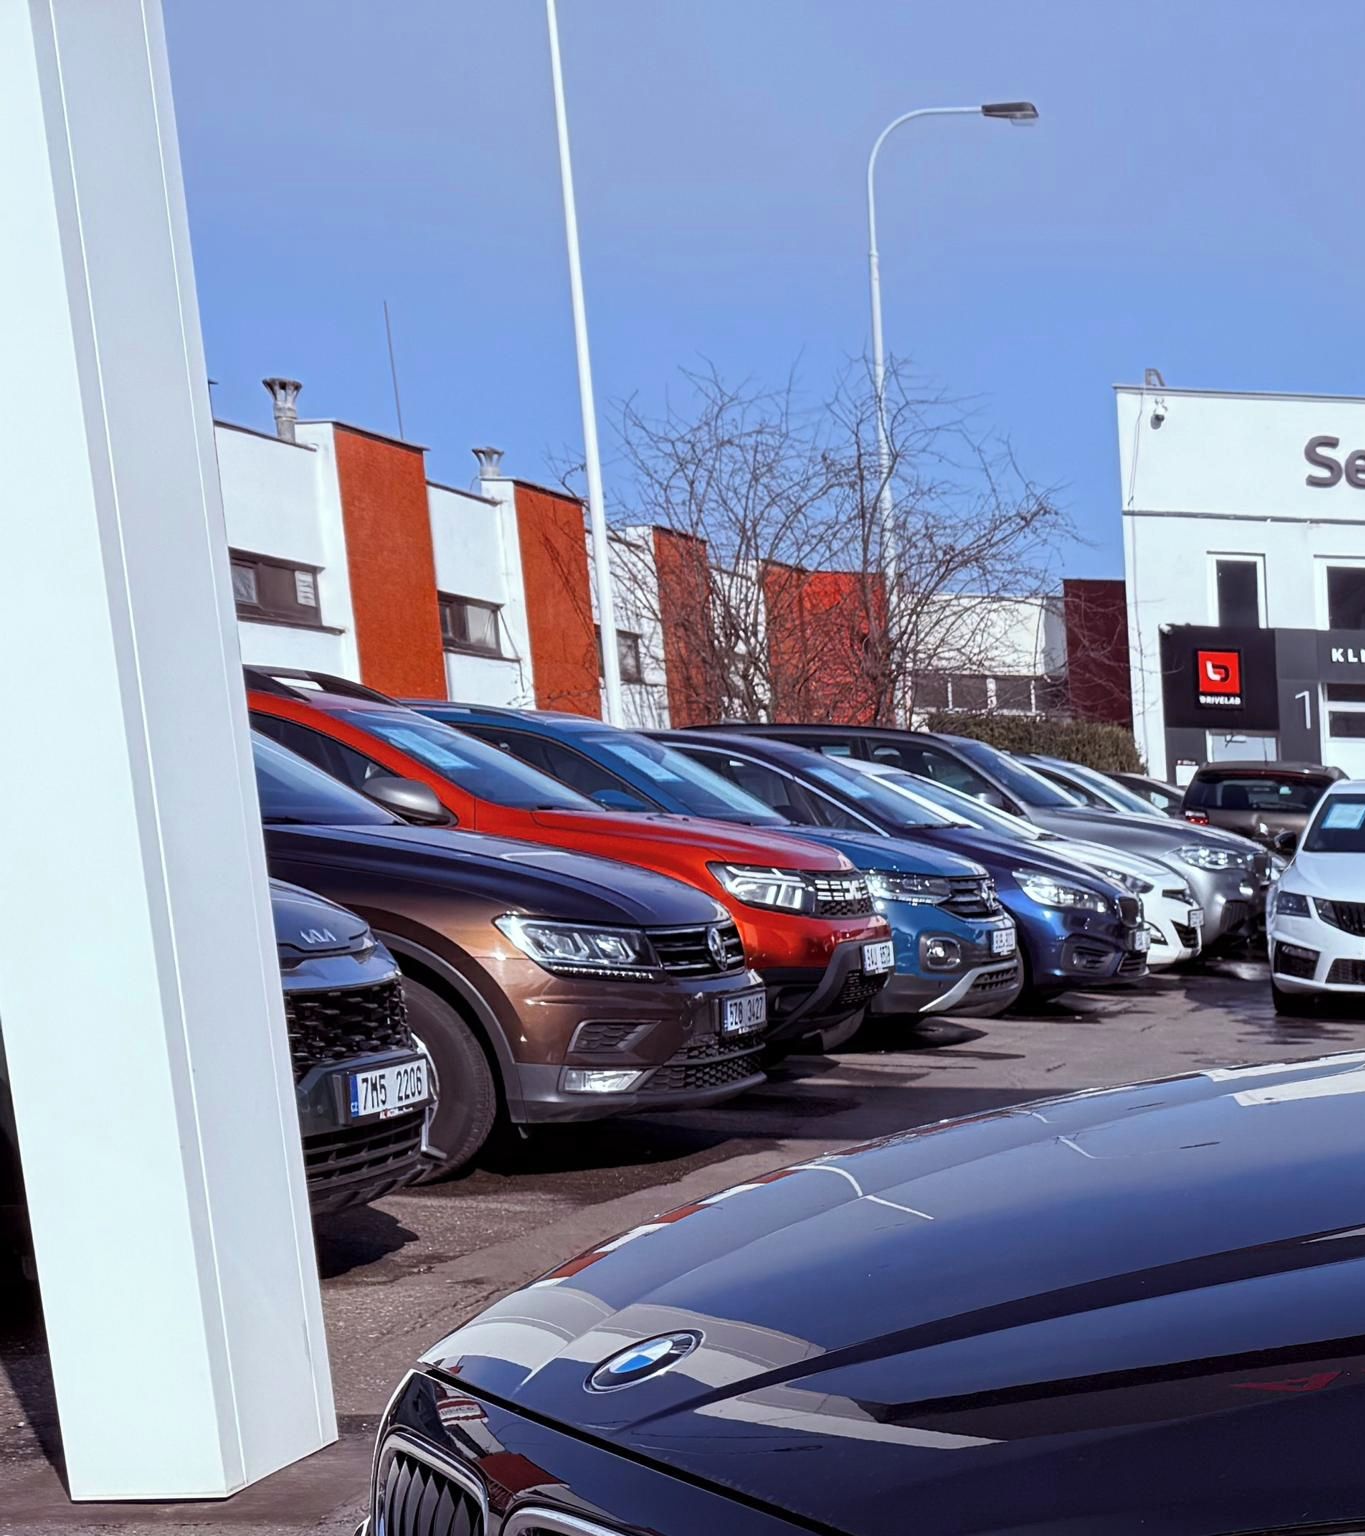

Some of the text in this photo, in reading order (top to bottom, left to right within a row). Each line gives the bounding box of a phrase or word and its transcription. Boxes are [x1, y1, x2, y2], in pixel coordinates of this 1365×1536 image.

[1198, 694, 1242, 705] DRIVELAB
[1295, 690, 1313, 731] 1
[395, 1064, 422, 1102] 2206
